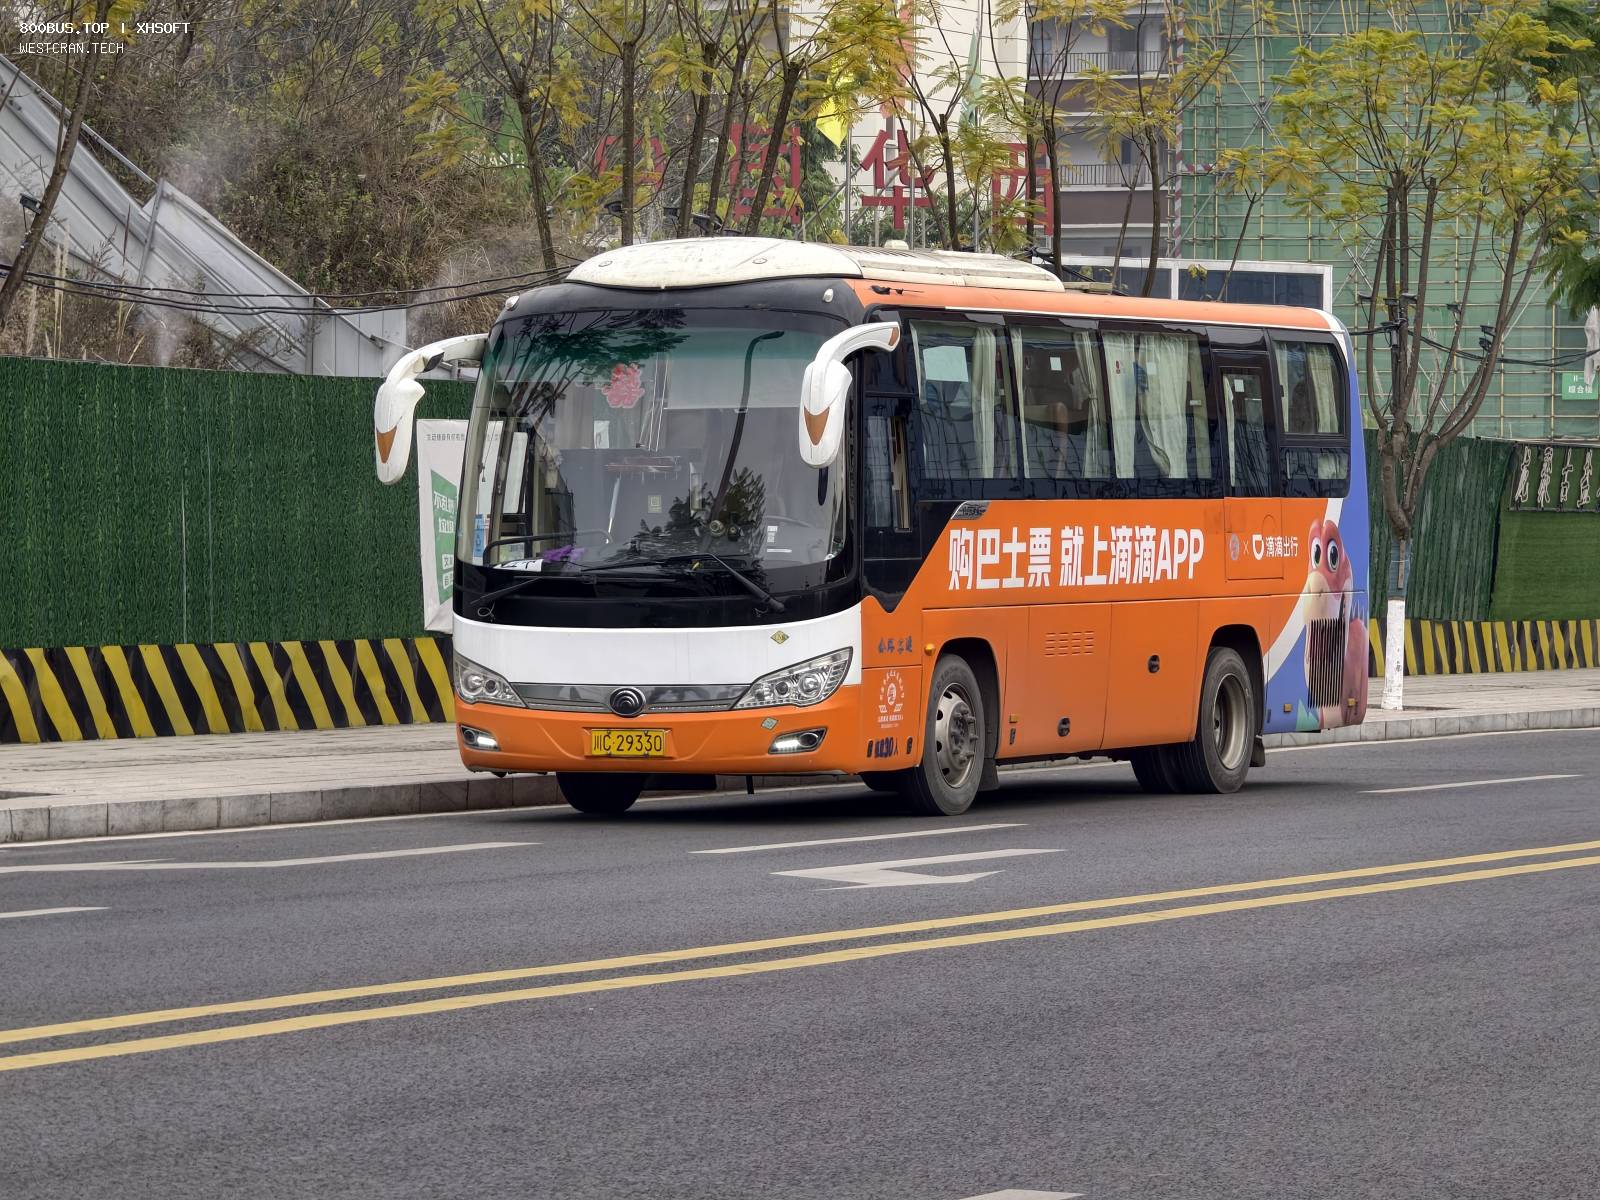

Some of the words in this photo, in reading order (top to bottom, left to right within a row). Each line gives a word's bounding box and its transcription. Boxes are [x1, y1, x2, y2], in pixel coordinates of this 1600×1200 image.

[948, 527, 1053, 591] 购巴士票
[1059, 524, 1204, 587] 就上滴滴APP
[1265, 535, 1299, 558] 滴滴出行
